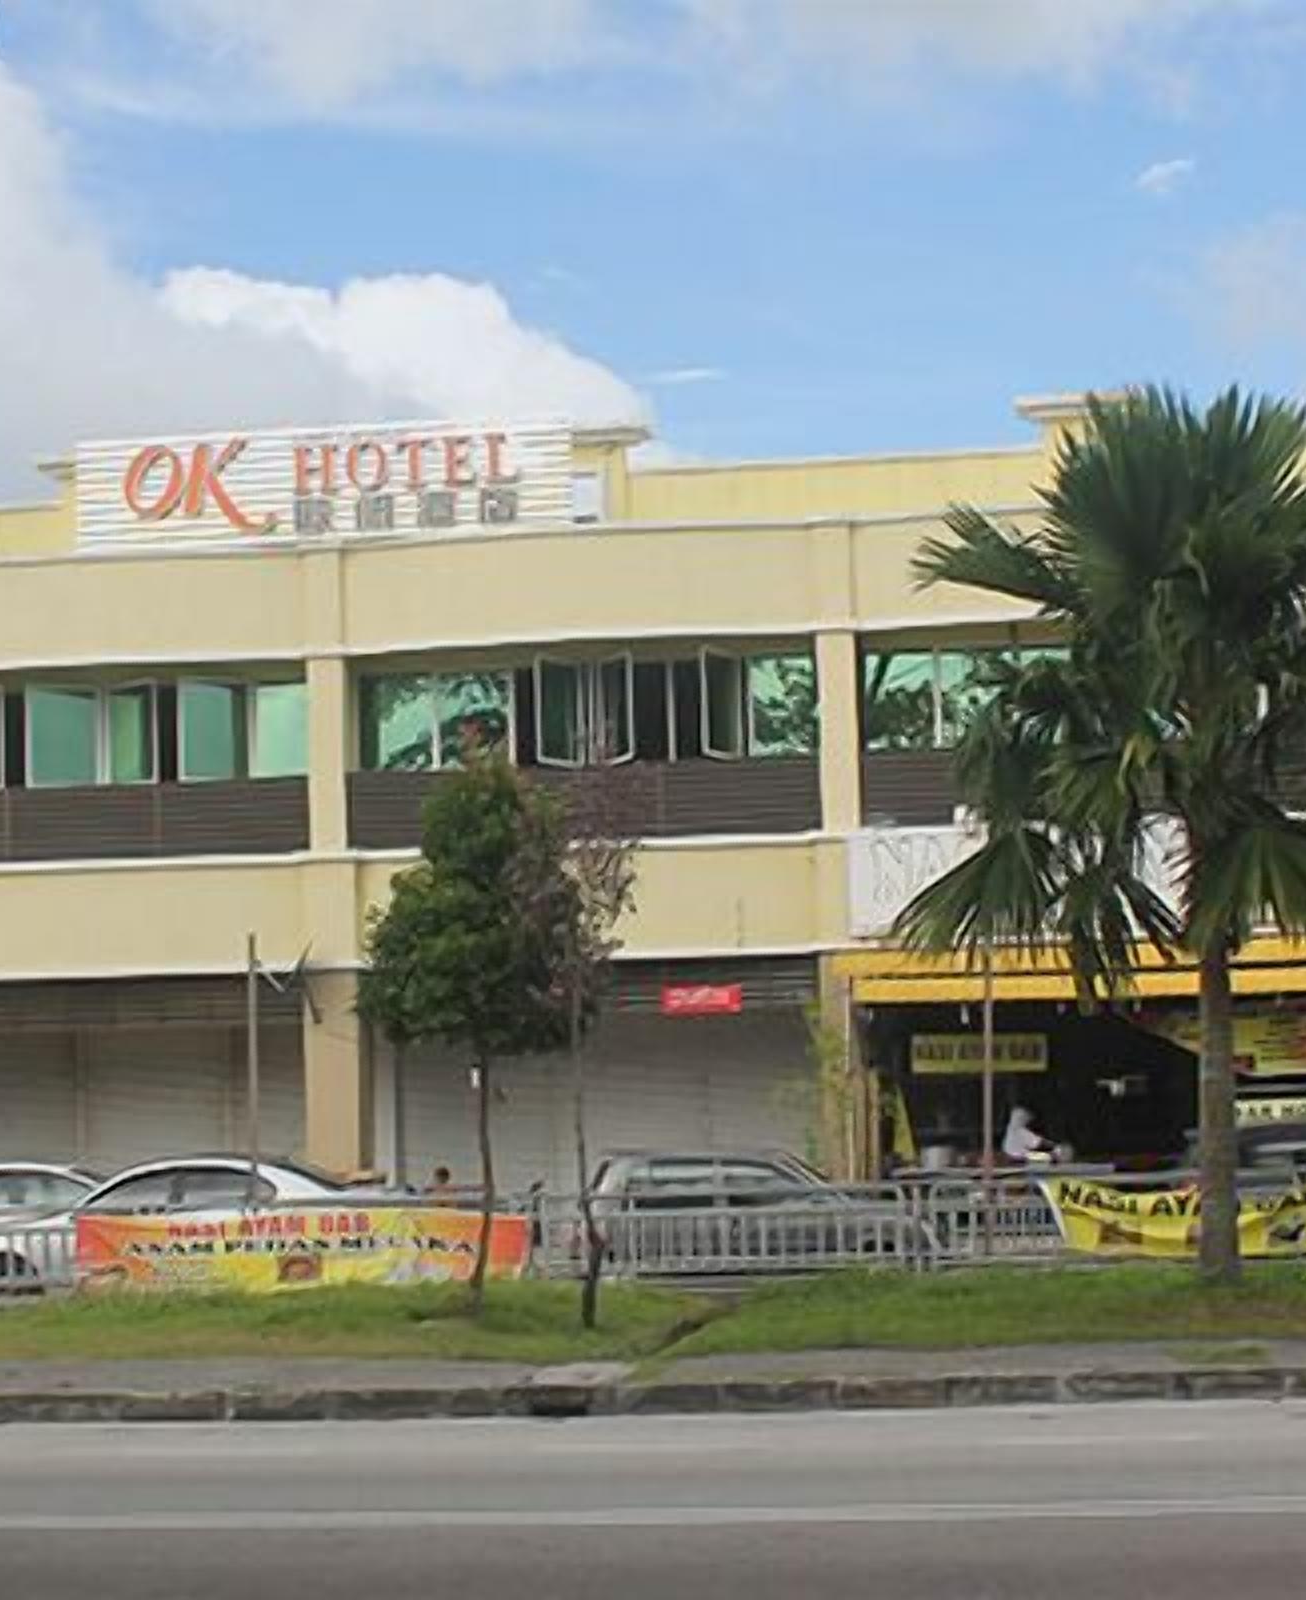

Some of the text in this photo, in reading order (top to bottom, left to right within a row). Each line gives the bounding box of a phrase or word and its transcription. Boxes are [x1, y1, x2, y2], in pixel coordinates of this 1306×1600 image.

[124, 433, 519, 534] OK HOTEL
[1059, 1182, 1138, 1213] NASI
[238, 1214, 306, 1235] AYAM
